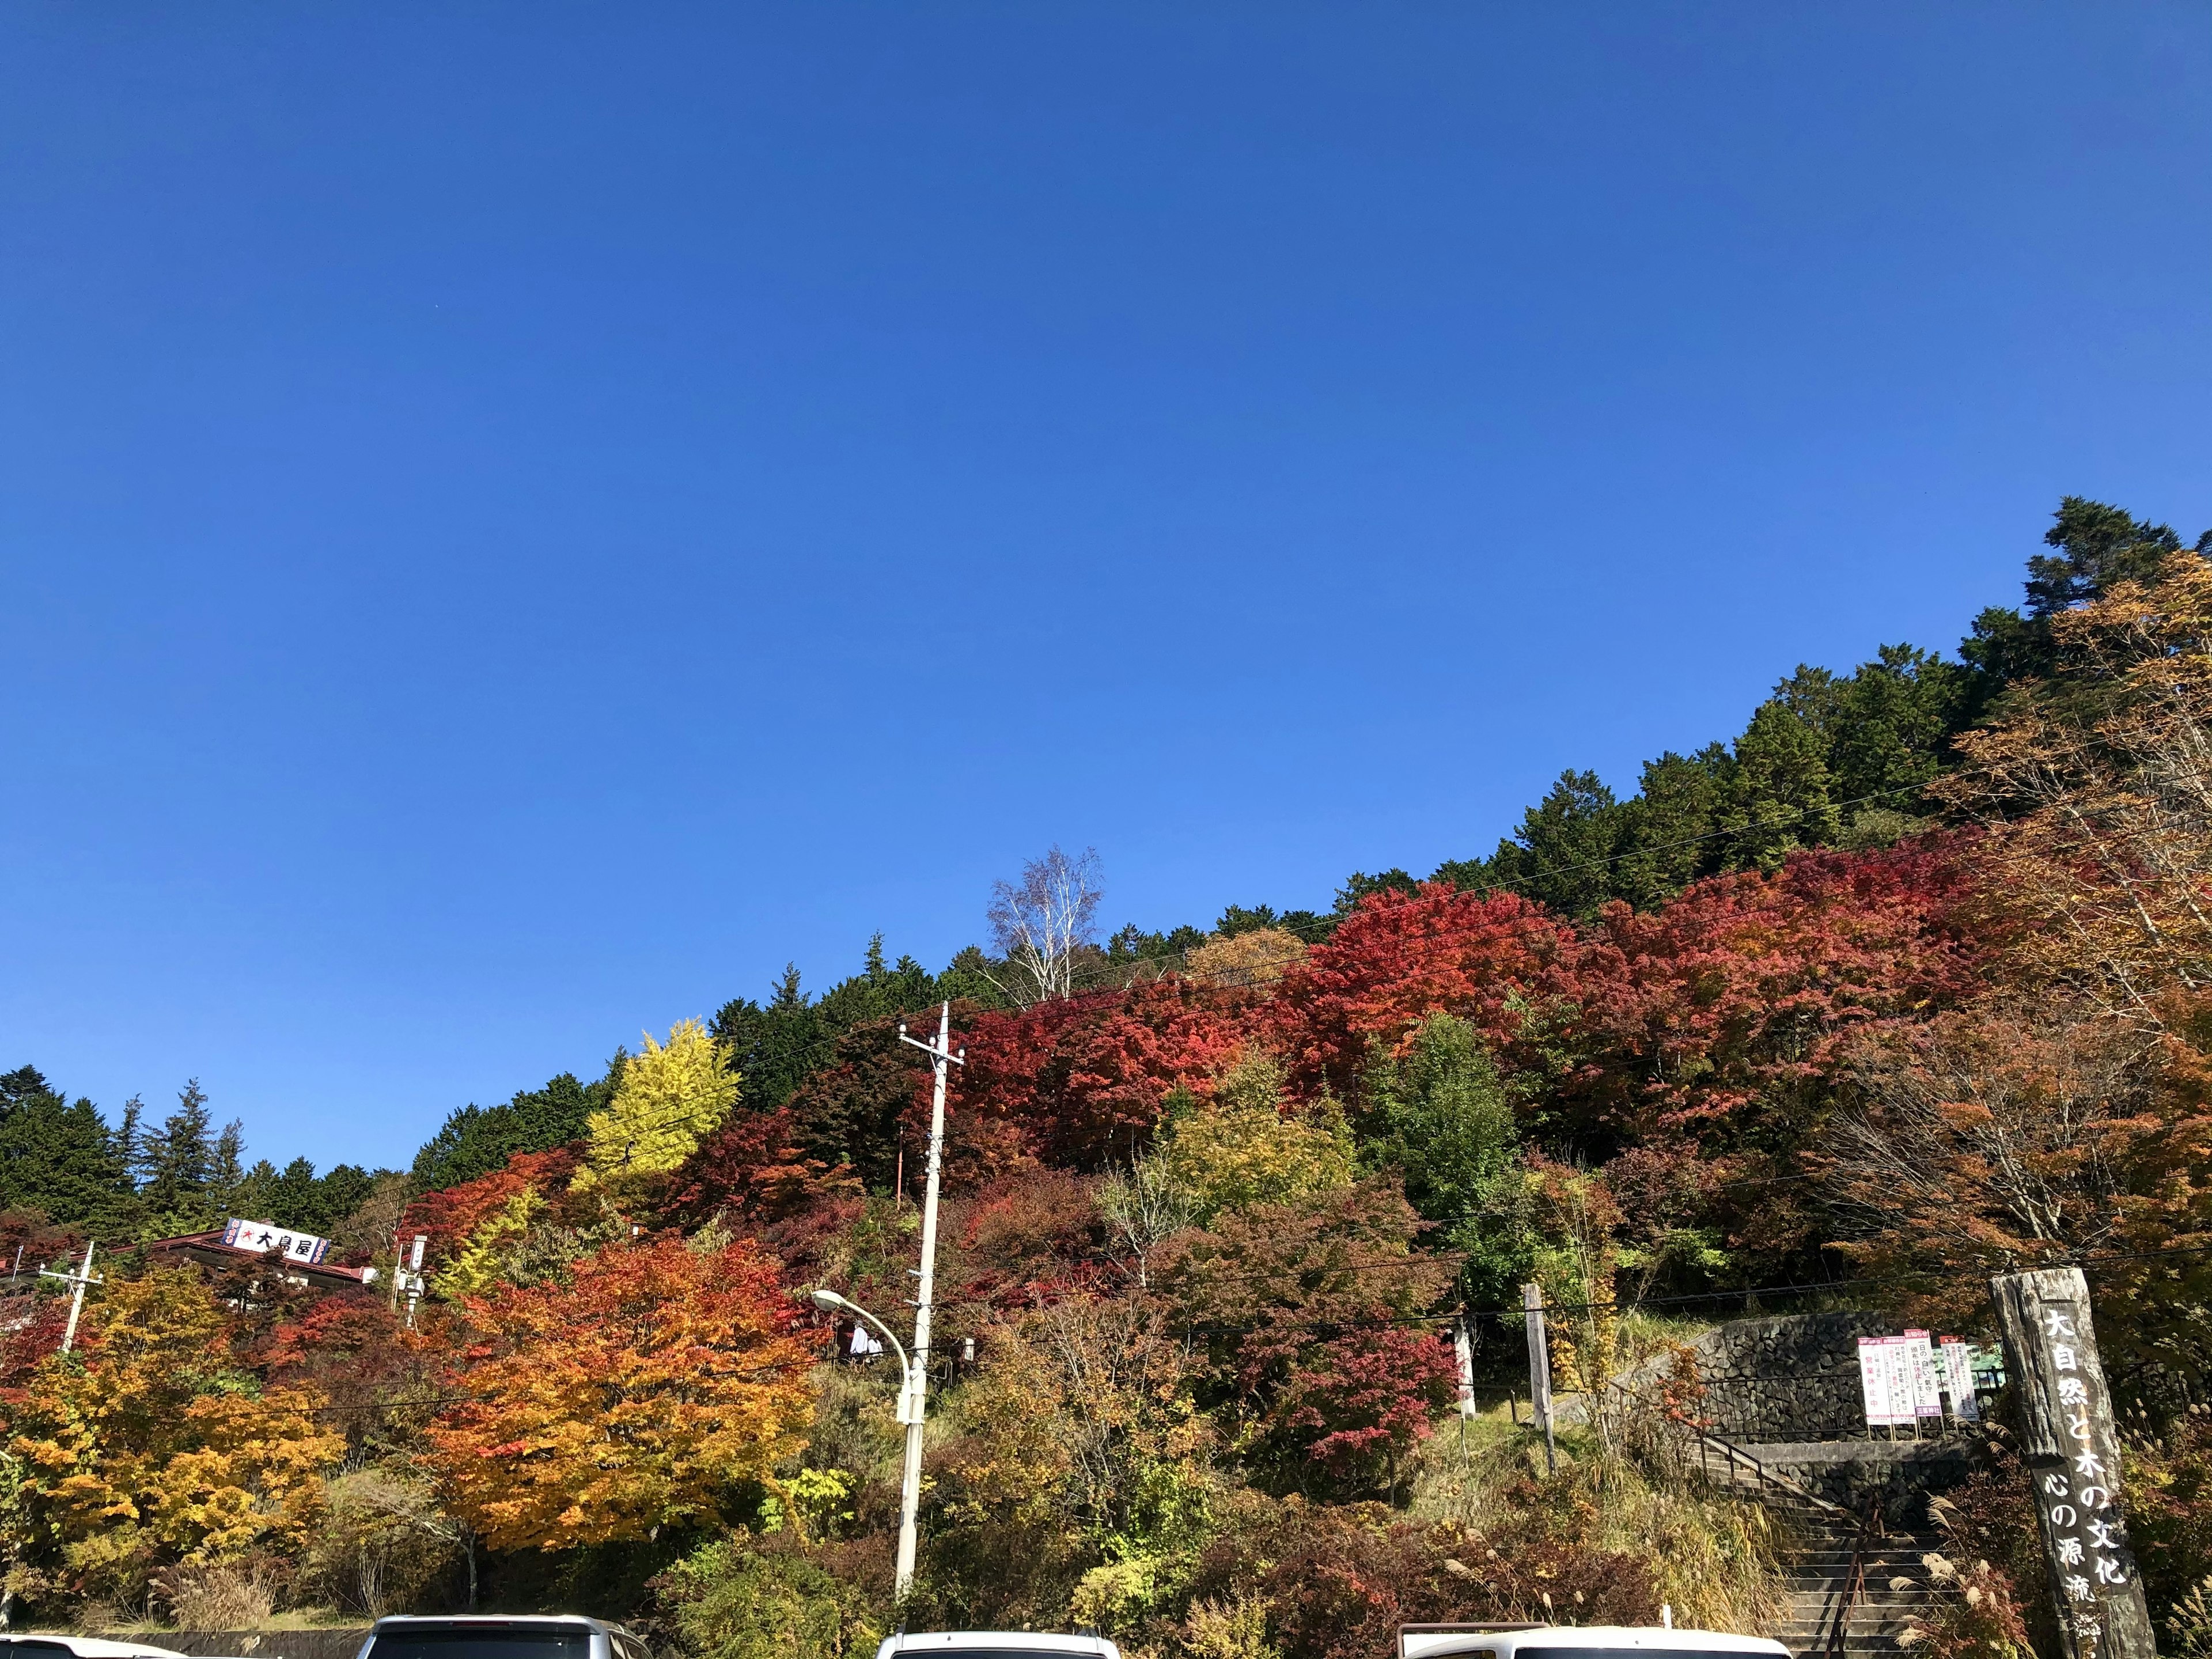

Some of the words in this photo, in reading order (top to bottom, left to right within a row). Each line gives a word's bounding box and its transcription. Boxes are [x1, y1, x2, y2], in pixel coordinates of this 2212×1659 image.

[257, 1232, 312, 1256] 大島屋
[1905, 1330, 1927, 1338] お知らせ
[1866, 1357, 1878, 1407] 営業休止中
[1911, 1347, 1926, 1405] 頒布は休止しました
[2044, 1309, 2127, 1585] 大自然と木の文化
